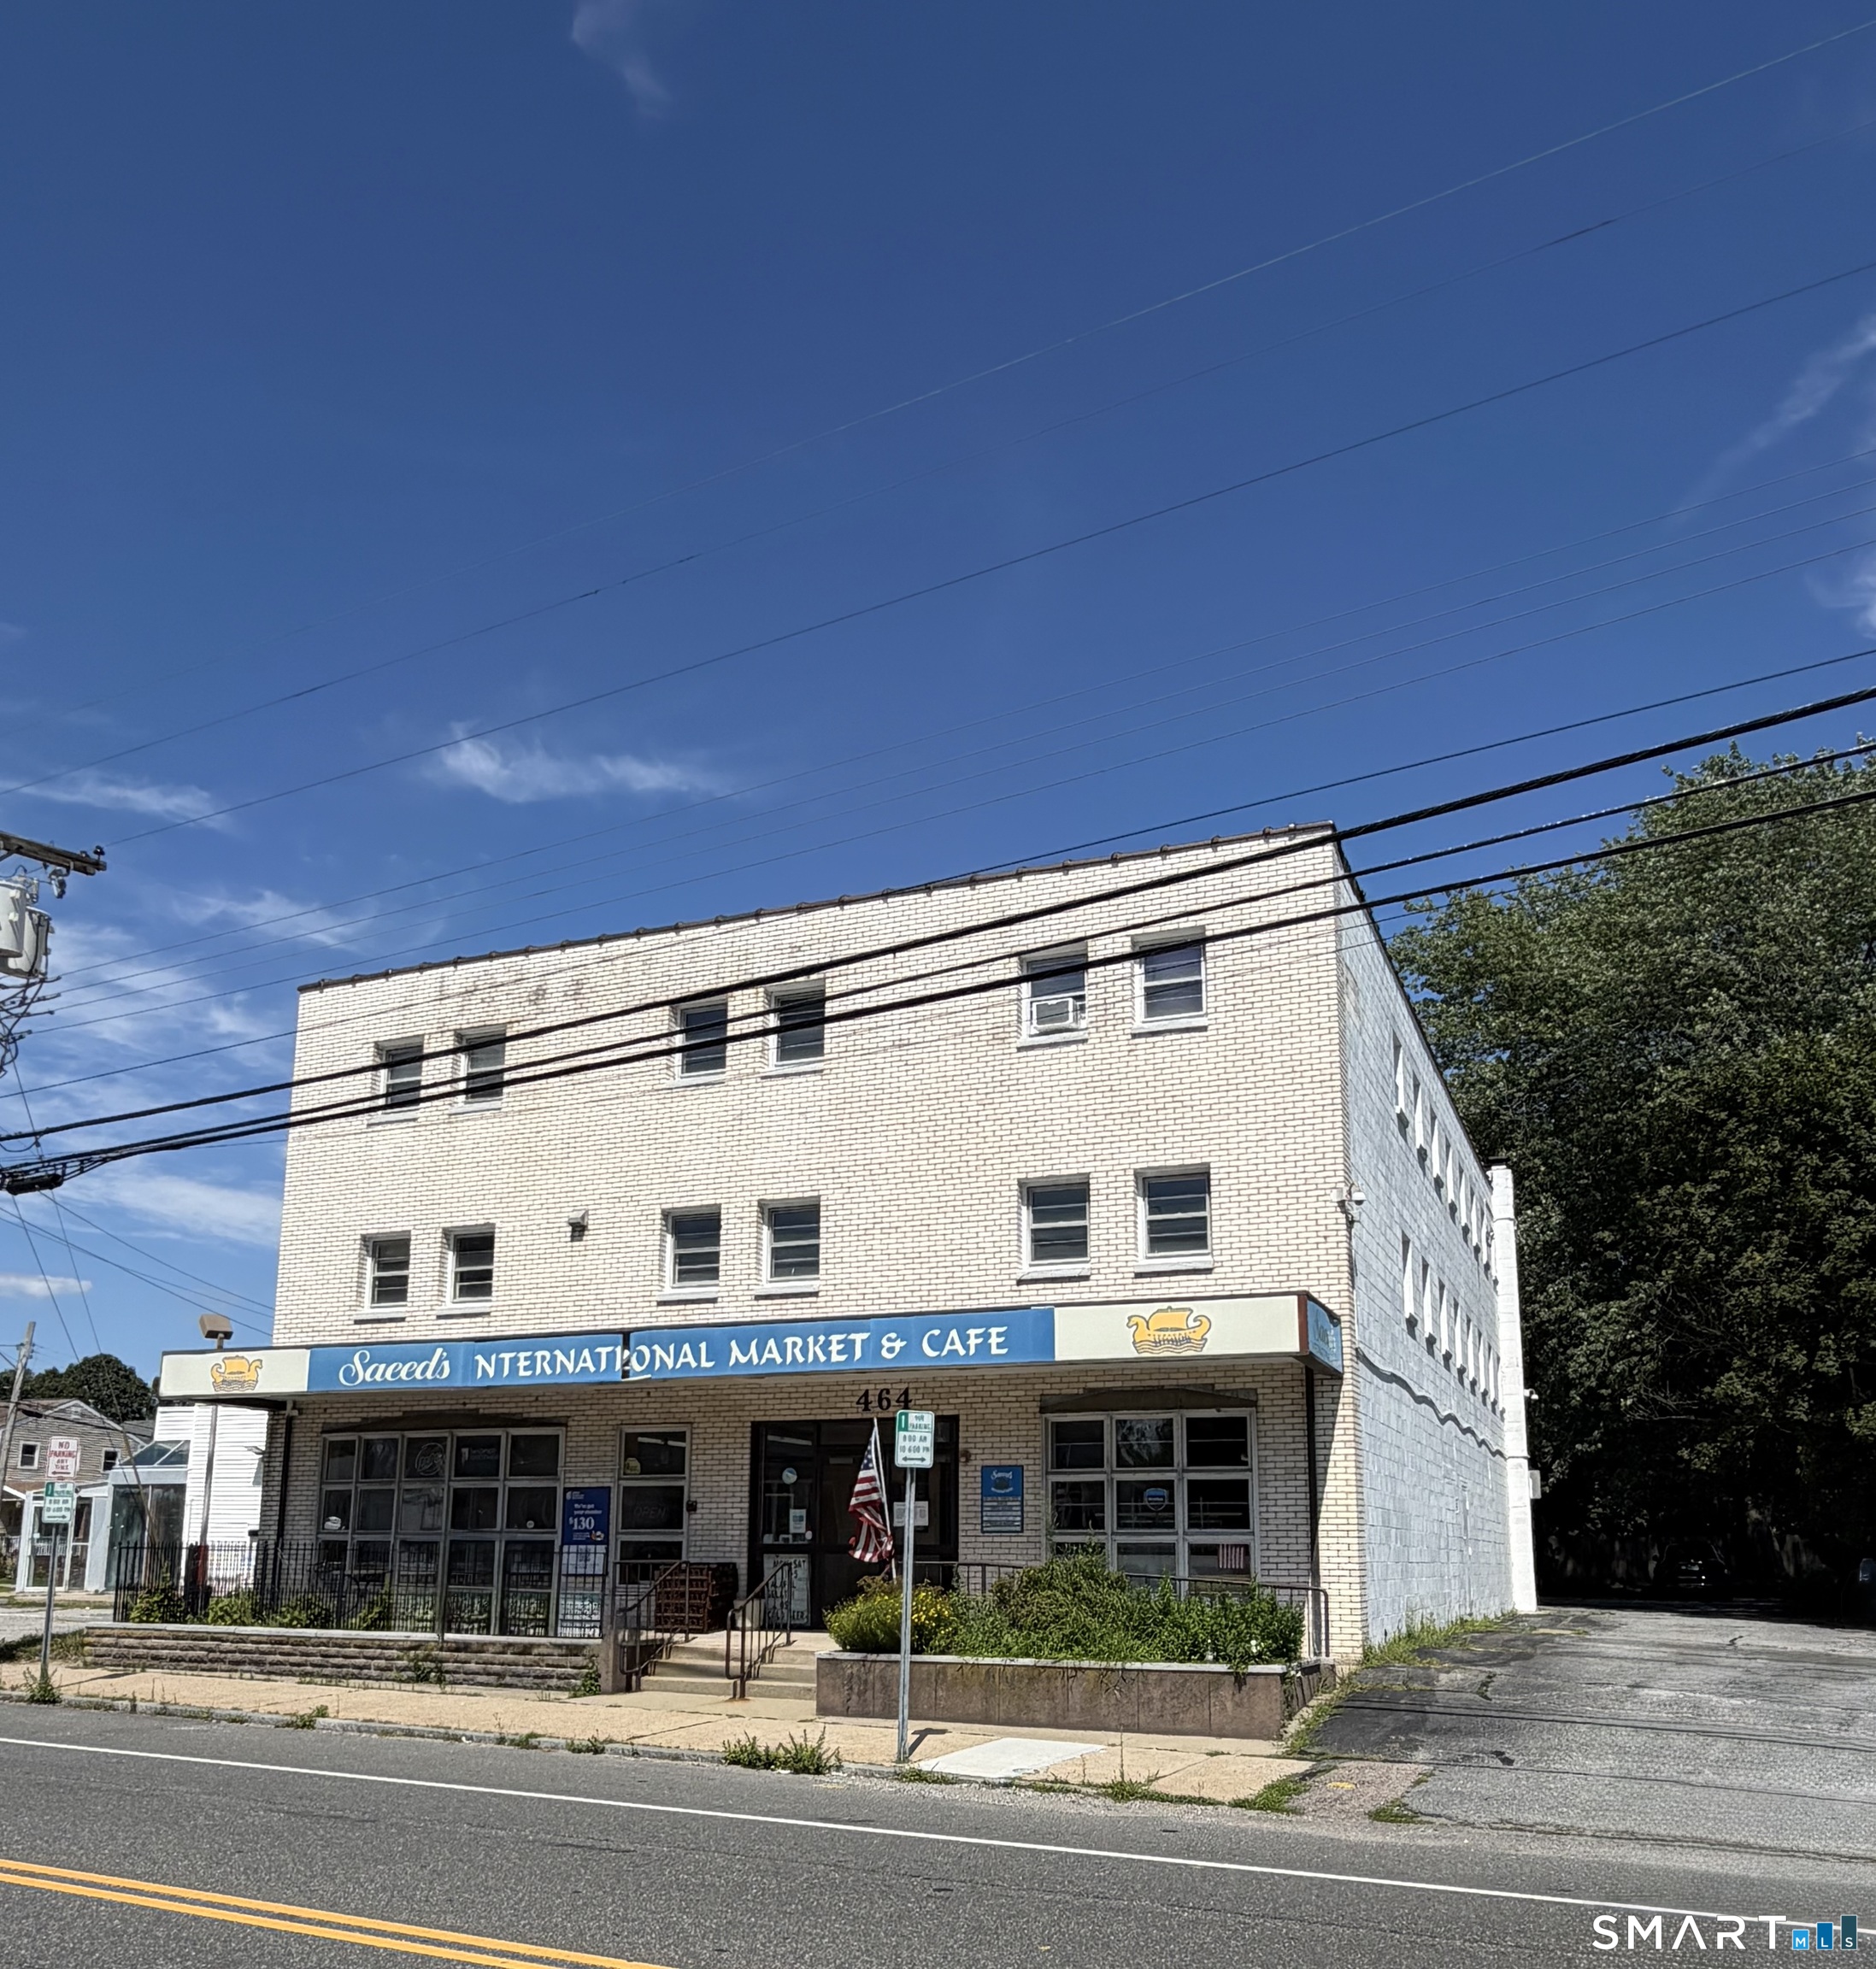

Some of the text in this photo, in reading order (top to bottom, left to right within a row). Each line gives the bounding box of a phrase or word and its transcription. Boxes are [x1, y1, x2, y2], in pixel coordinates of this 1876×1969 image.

[729, 1331, 870, 1367] MARKET
[881, 1331, 907, 1360] &
[922, 1325, 1009, 1358] CAFE
[338, 1347, 450, 1386] Saeed's
[856, 1387, 913, 1411] 464
[58, 1441, 70, 1449] NO
